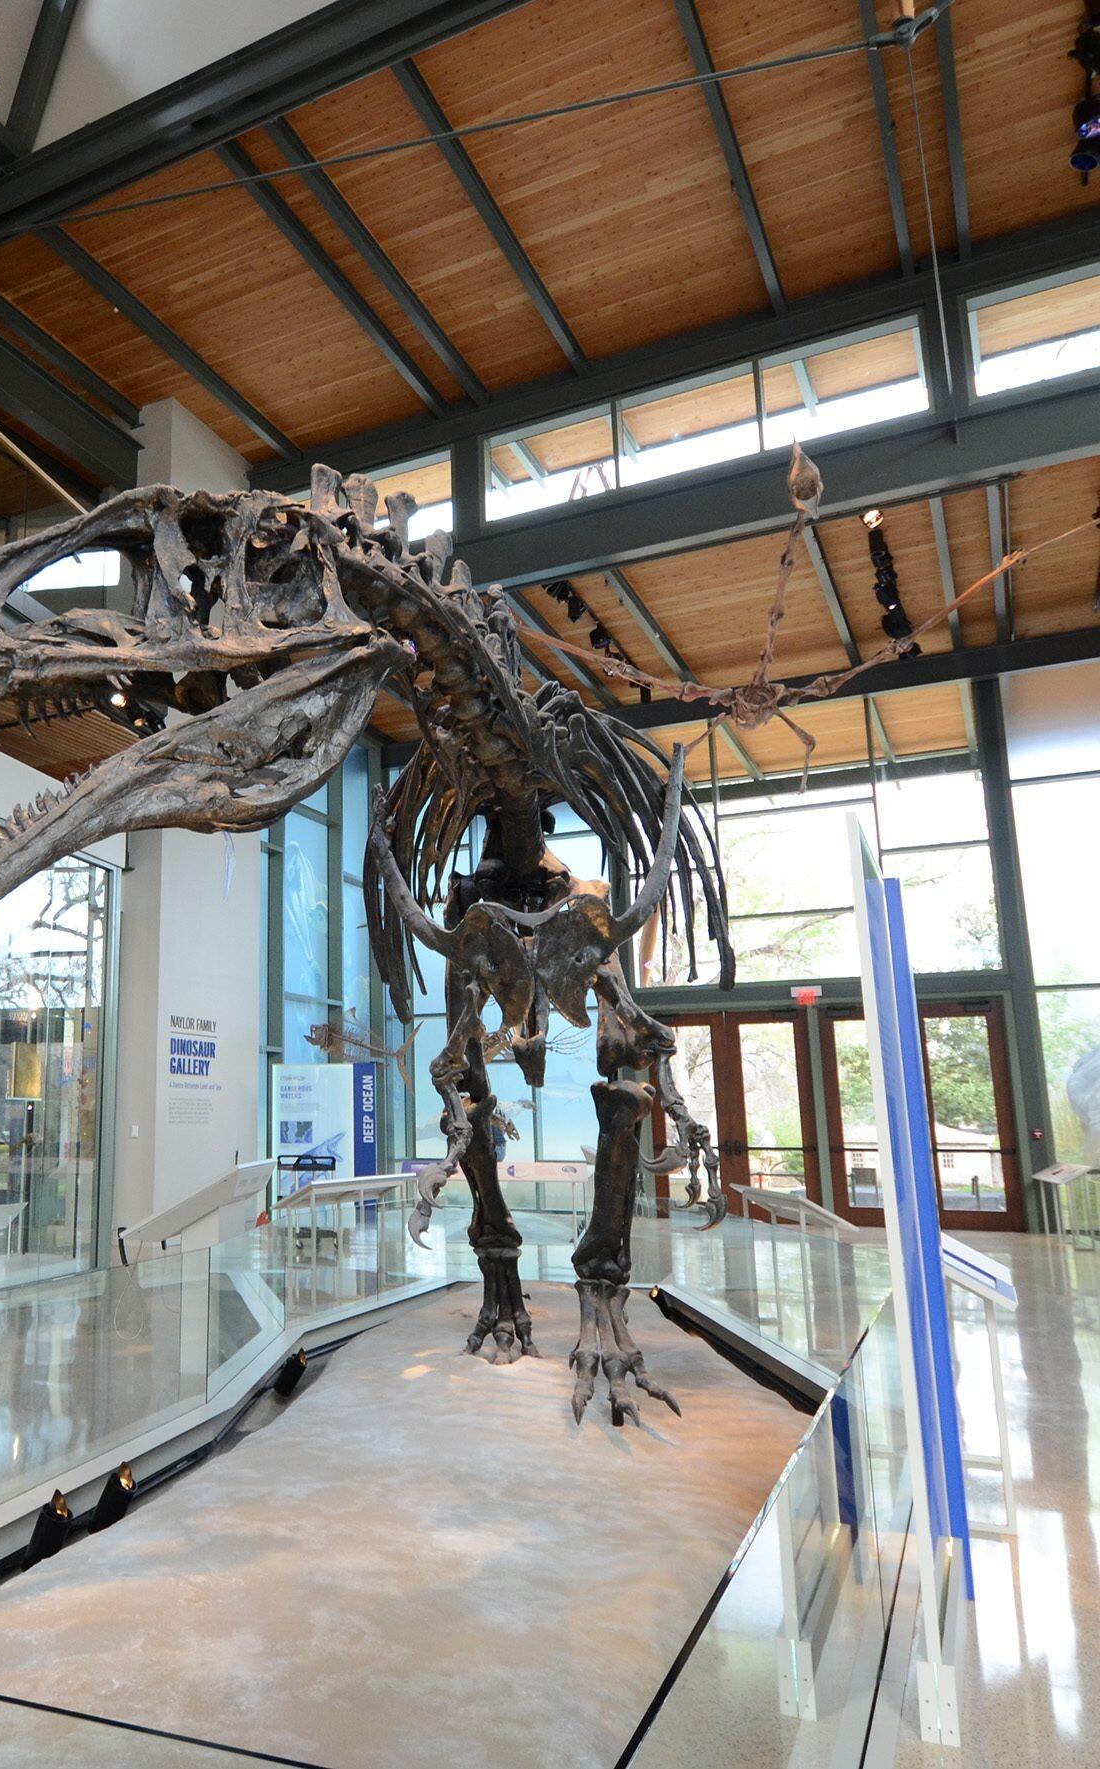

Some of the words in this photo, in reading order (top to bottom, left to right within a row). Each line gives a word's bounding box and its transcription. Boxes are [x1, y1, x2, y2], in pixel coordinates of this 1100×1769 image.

[170, 1015, 194, 1030] NAYLOR
[196, 1018, 216, 1033] FAMILY
[170, 1038, 215, 1058] DINOSAUR
[170, 1057, 210, 1076] GALLERY
[362, 1075, 374, 1112] OCEAN
[363, 1115, 374, 1143] DEEP
